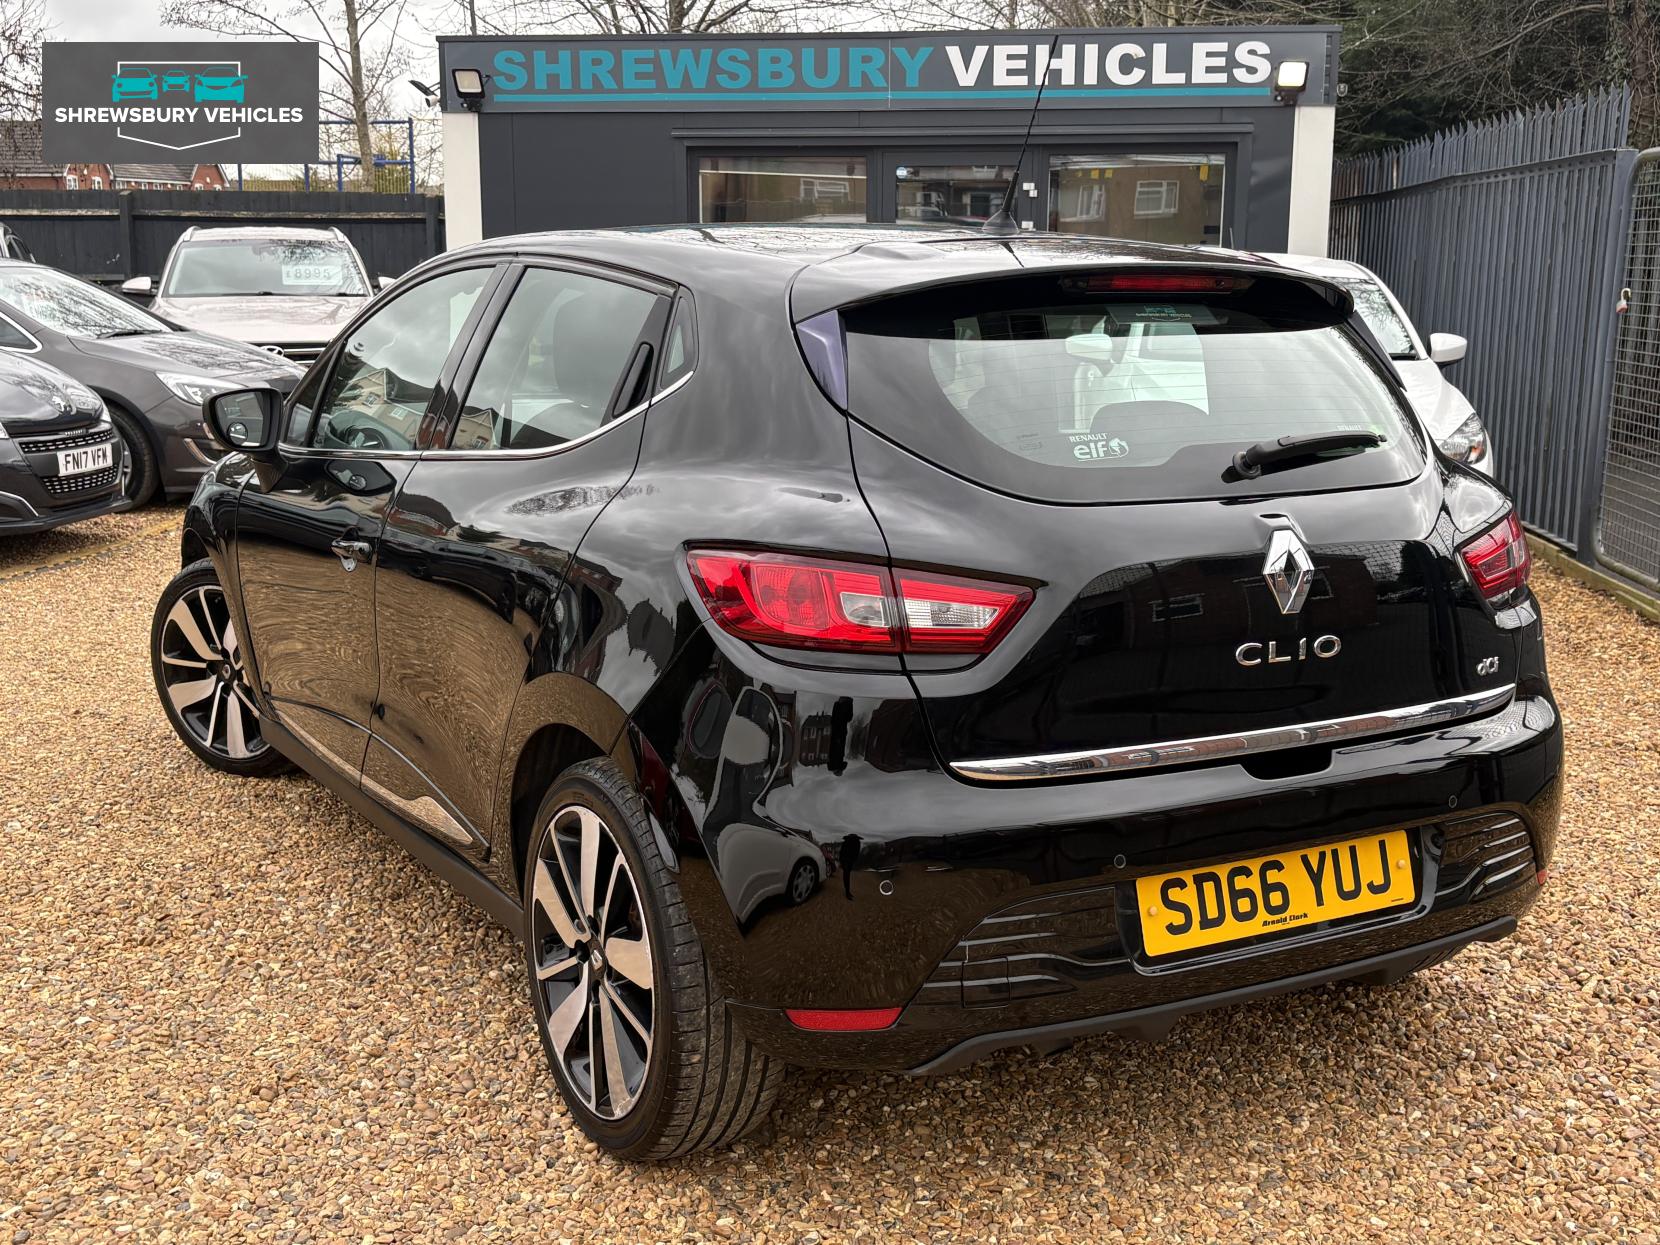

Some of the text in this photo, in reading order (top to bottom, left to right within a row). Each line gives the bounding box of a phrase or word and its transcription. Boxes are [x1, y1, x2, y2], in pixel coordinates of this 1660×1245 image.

[493, 41, 1272, 90] SHREWSBURY VEHICLES
[1069, 432, 1108, 443] RENAULT
[1073, 441, 1107, 460] elf
[64, 451, 88, 472] FN17
[1235, 634, 1342, 666] CLIO
[1160, 839, 1392, 936] SD66 YUJ
[1261, 915, 1288, 927] Arnold
